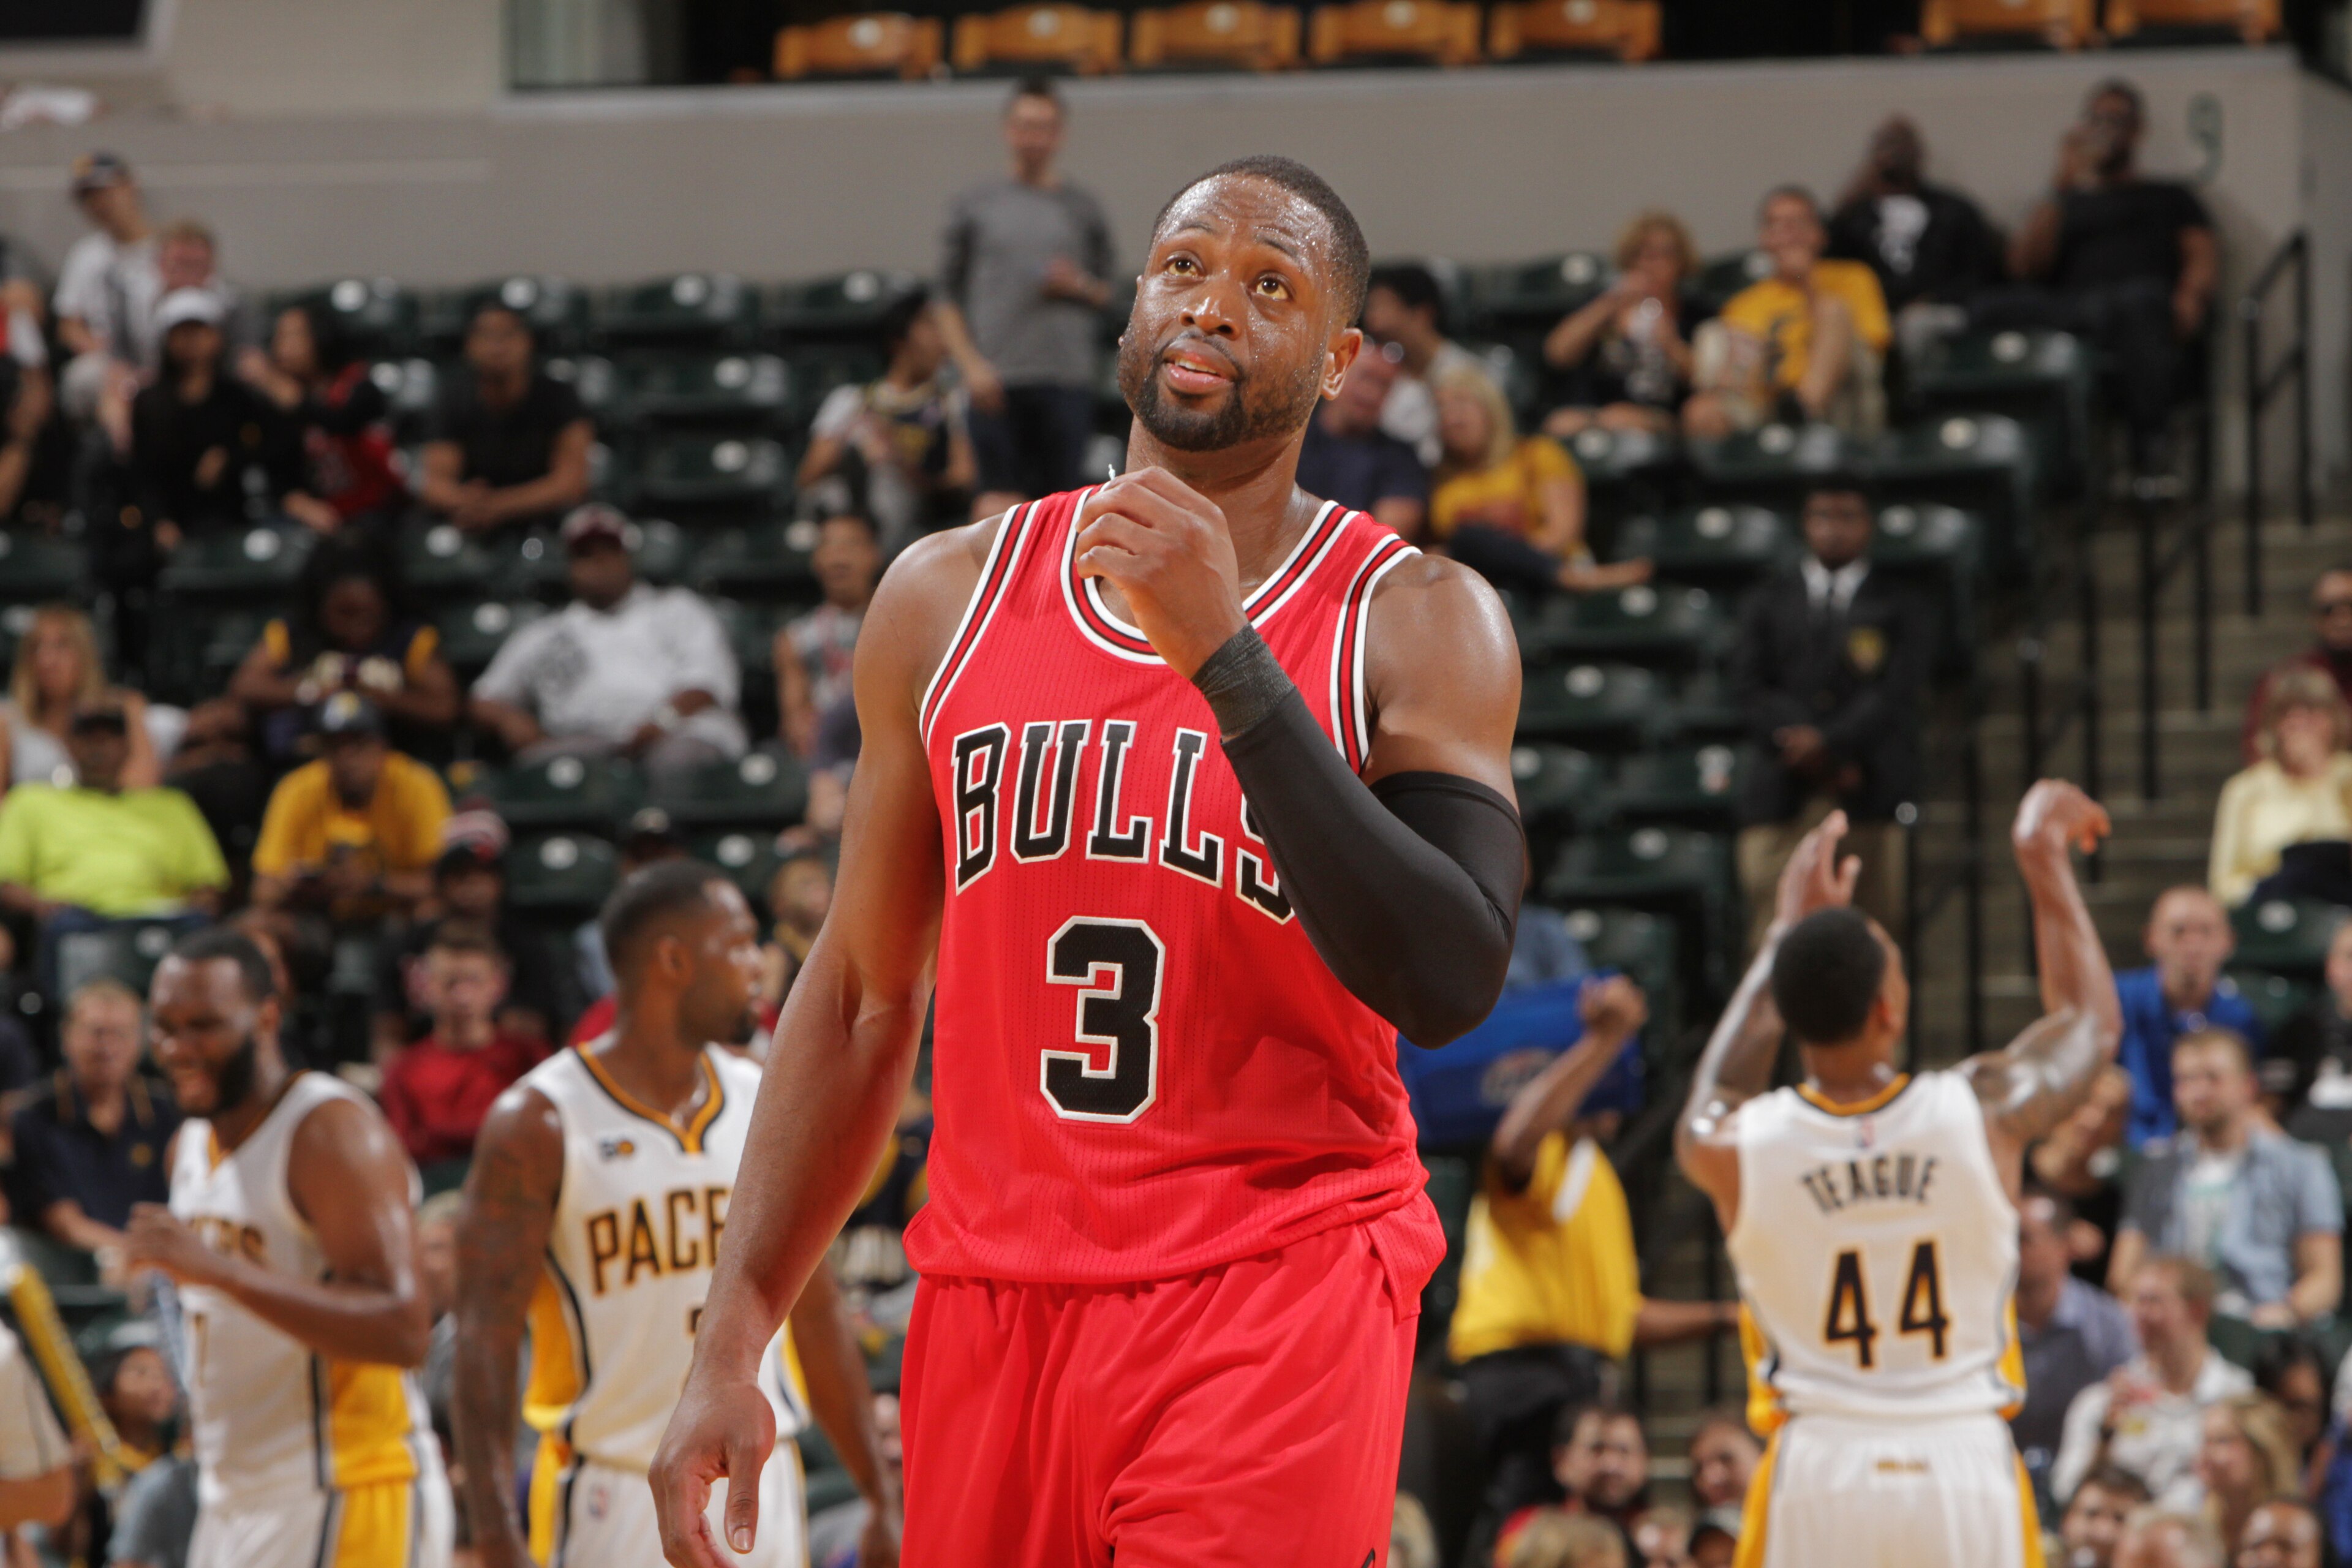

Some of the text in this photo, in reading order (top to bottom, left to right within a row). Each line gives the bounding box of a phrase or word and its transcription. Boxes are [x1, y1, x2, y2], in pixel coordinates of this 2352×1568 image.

[1039, 915, 1166, 1124] 3
[1799, 1154, 1937, 1214] TEAGUE
[1823, 1238, 1950, 1370] 44
